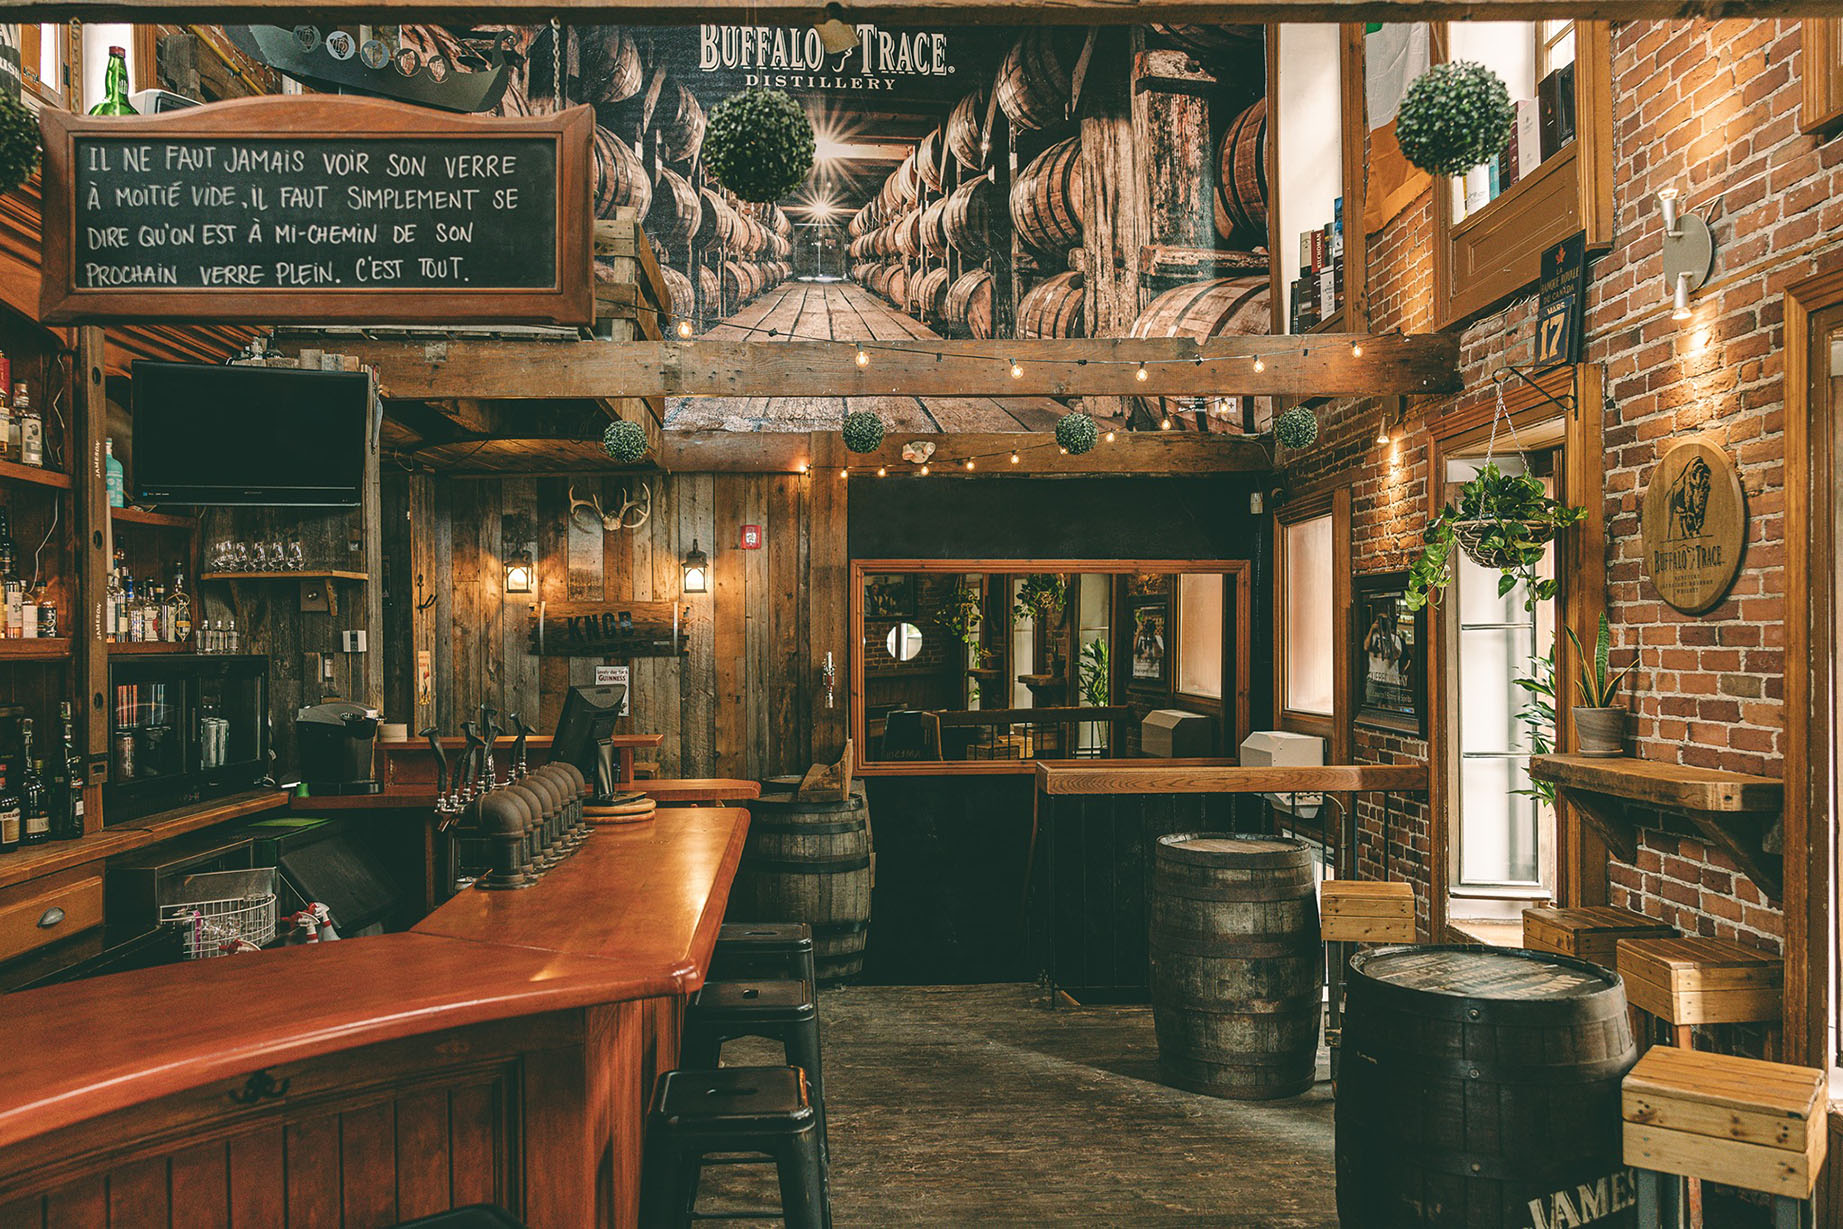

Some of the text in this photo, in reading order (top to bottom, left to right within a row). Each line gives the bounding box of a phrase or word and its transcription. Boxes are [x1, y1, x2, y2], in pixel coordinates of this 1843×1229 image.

[699, 23, 824, 72] BUFFALO
[745, 73, 896, 90] DISTILLERY
[88, 145, 517, 178] IL NE FAUT JAMAIS VOIR SON VERRE
[87, 181, 101, 211] À
[115, 181, 184, 208] MOITIÉ
[280, 185, 329, 209] FAUT
[347, 185, 481, 211] SIMPLEMENT
[492, 188, 519, 210] SE
[87, 217, 474, 251] DIRE QU'ON EST À MI-CHEMIN DE SON
[85, 255, 470, 288] PROCHAIN VERRE PLEIN. C'EST TOUT.
[1539, 312, 1565, 362] 17
[1655, 545, 1722, 574] BUFFALO TRACE
[567, 610, 634, 642] KNOB
